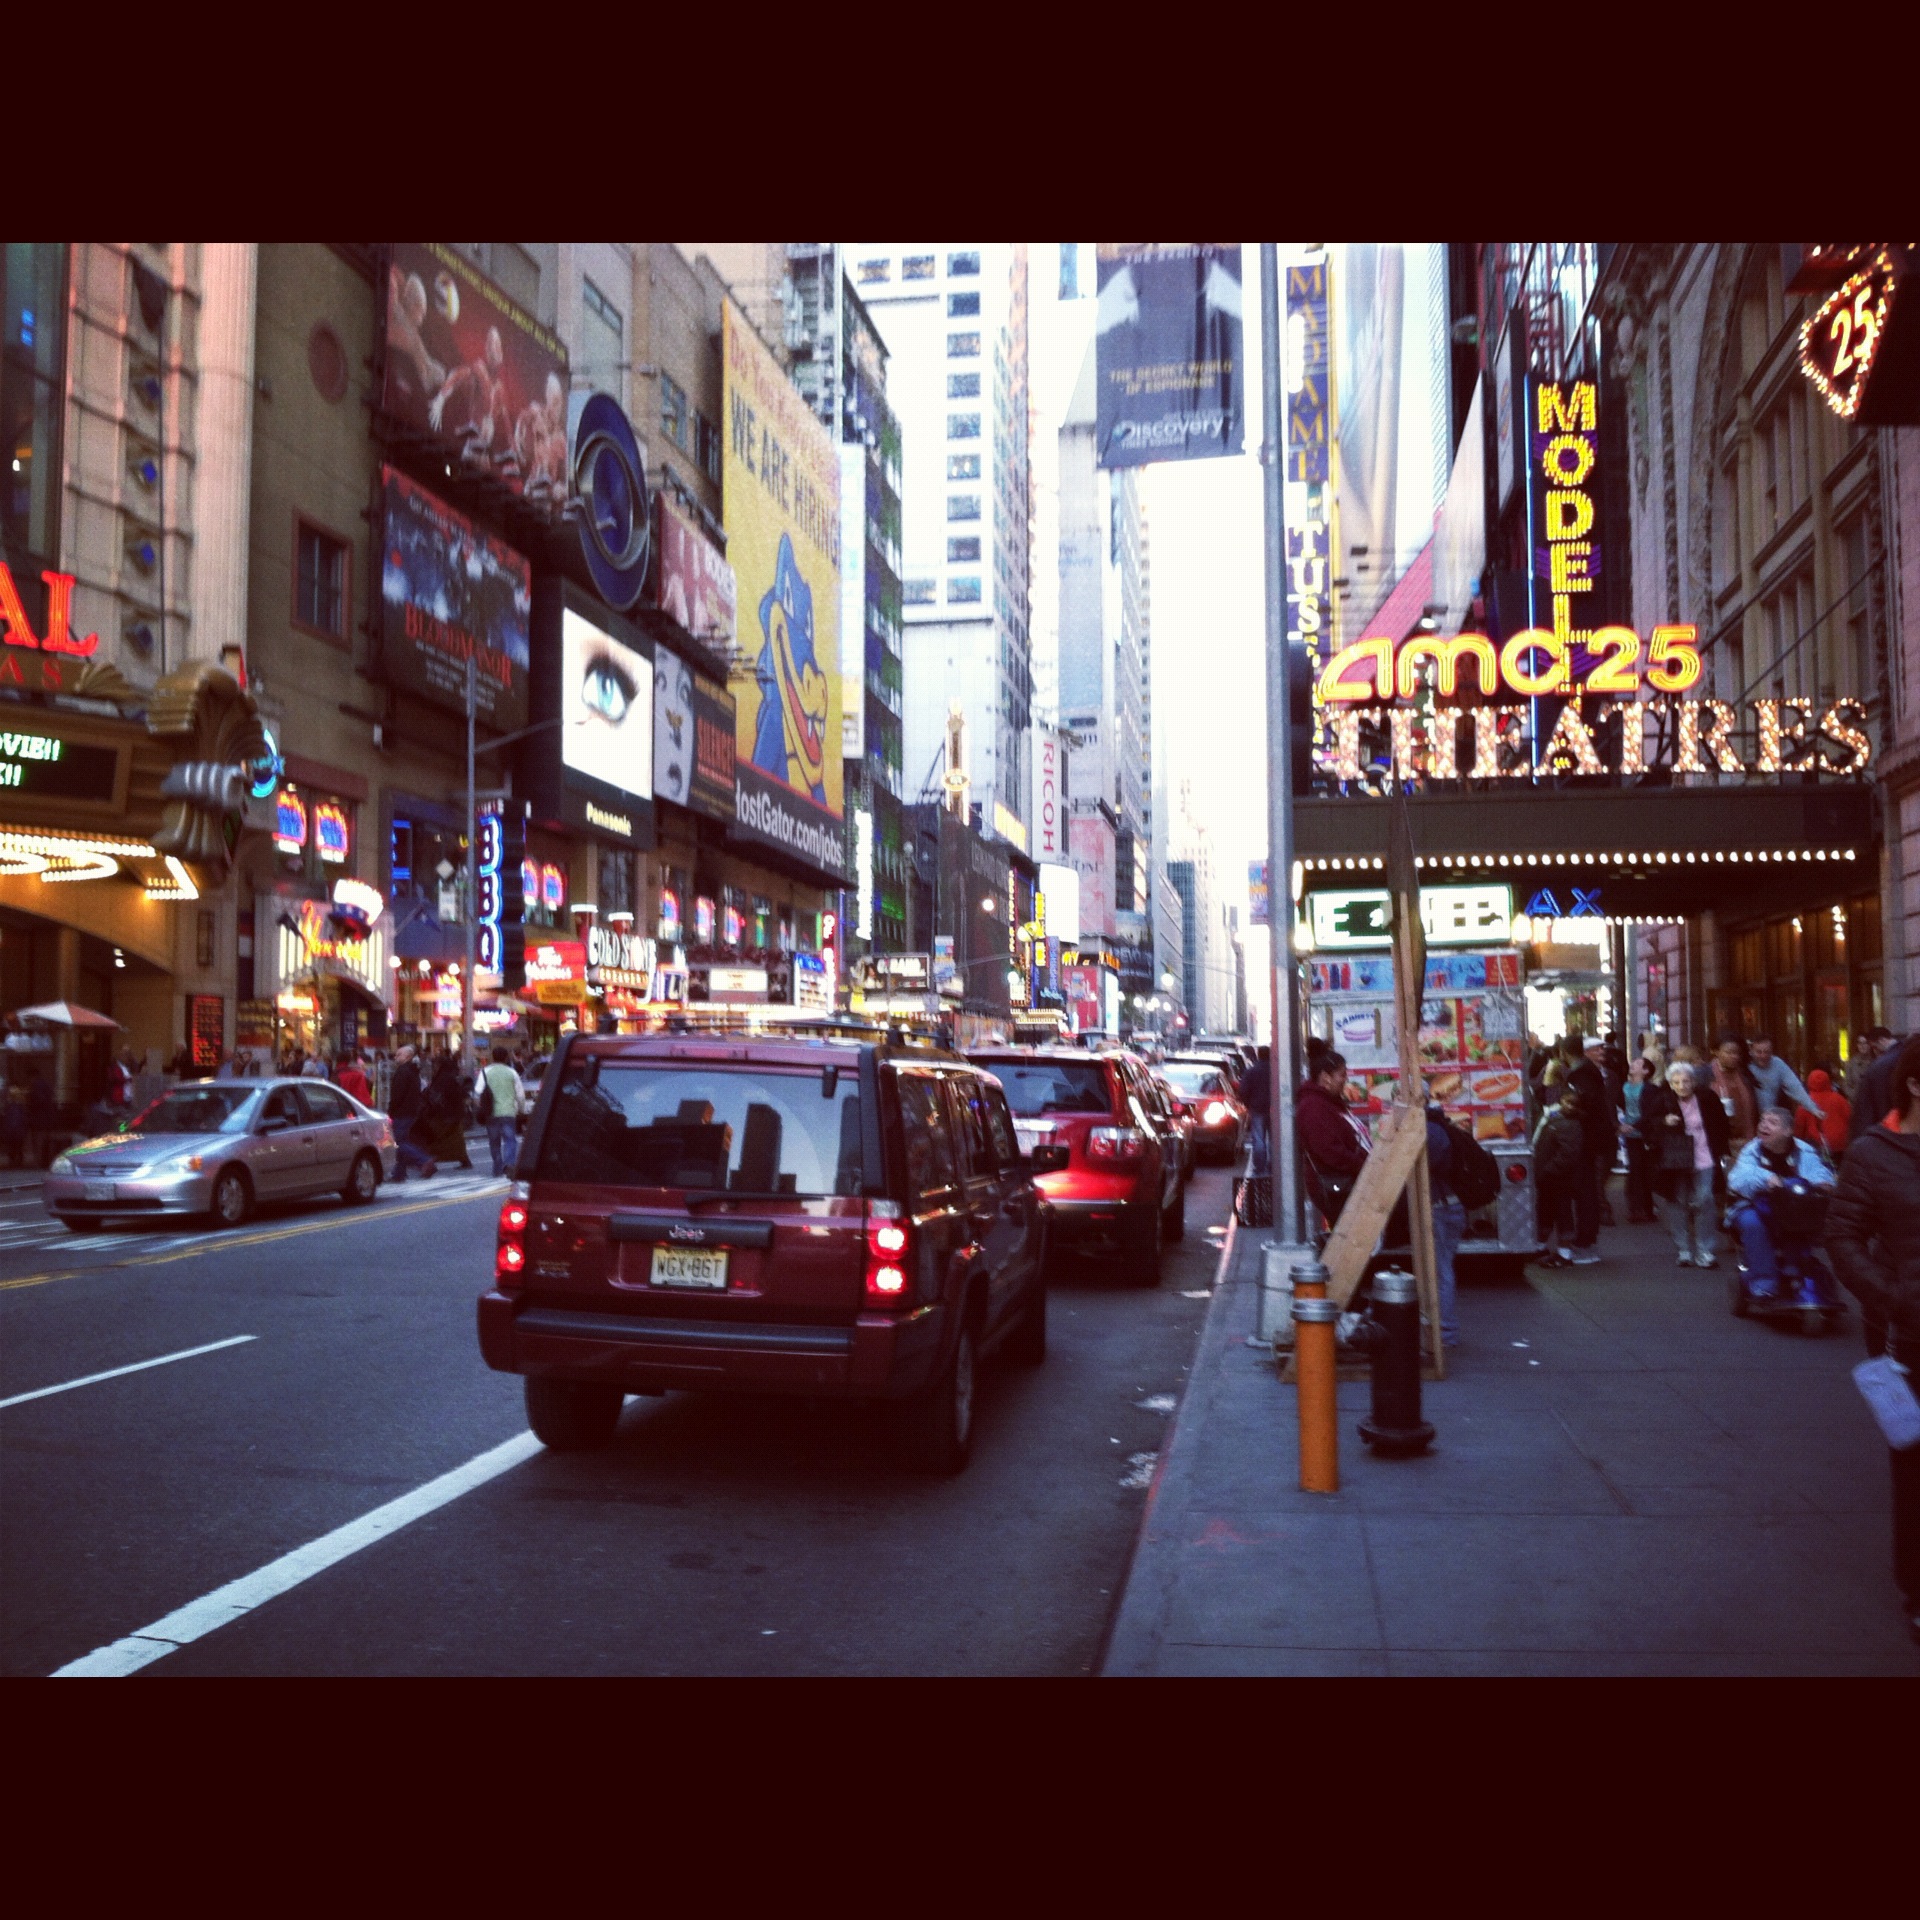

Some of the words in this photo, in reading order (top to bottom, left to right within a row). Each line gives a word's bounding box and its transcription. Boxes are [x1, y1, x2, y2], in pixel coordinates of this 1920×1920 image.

[1830, 286, 1877, 376] 25
[730, 385, 756, 475] WE
[761, 427, 790, 513] ARE
[1322, 697, 1872, 780] THEATRES
[586, 801, 632, 837] Panasonic
[1042, 741, 1056, 852] RICOH
